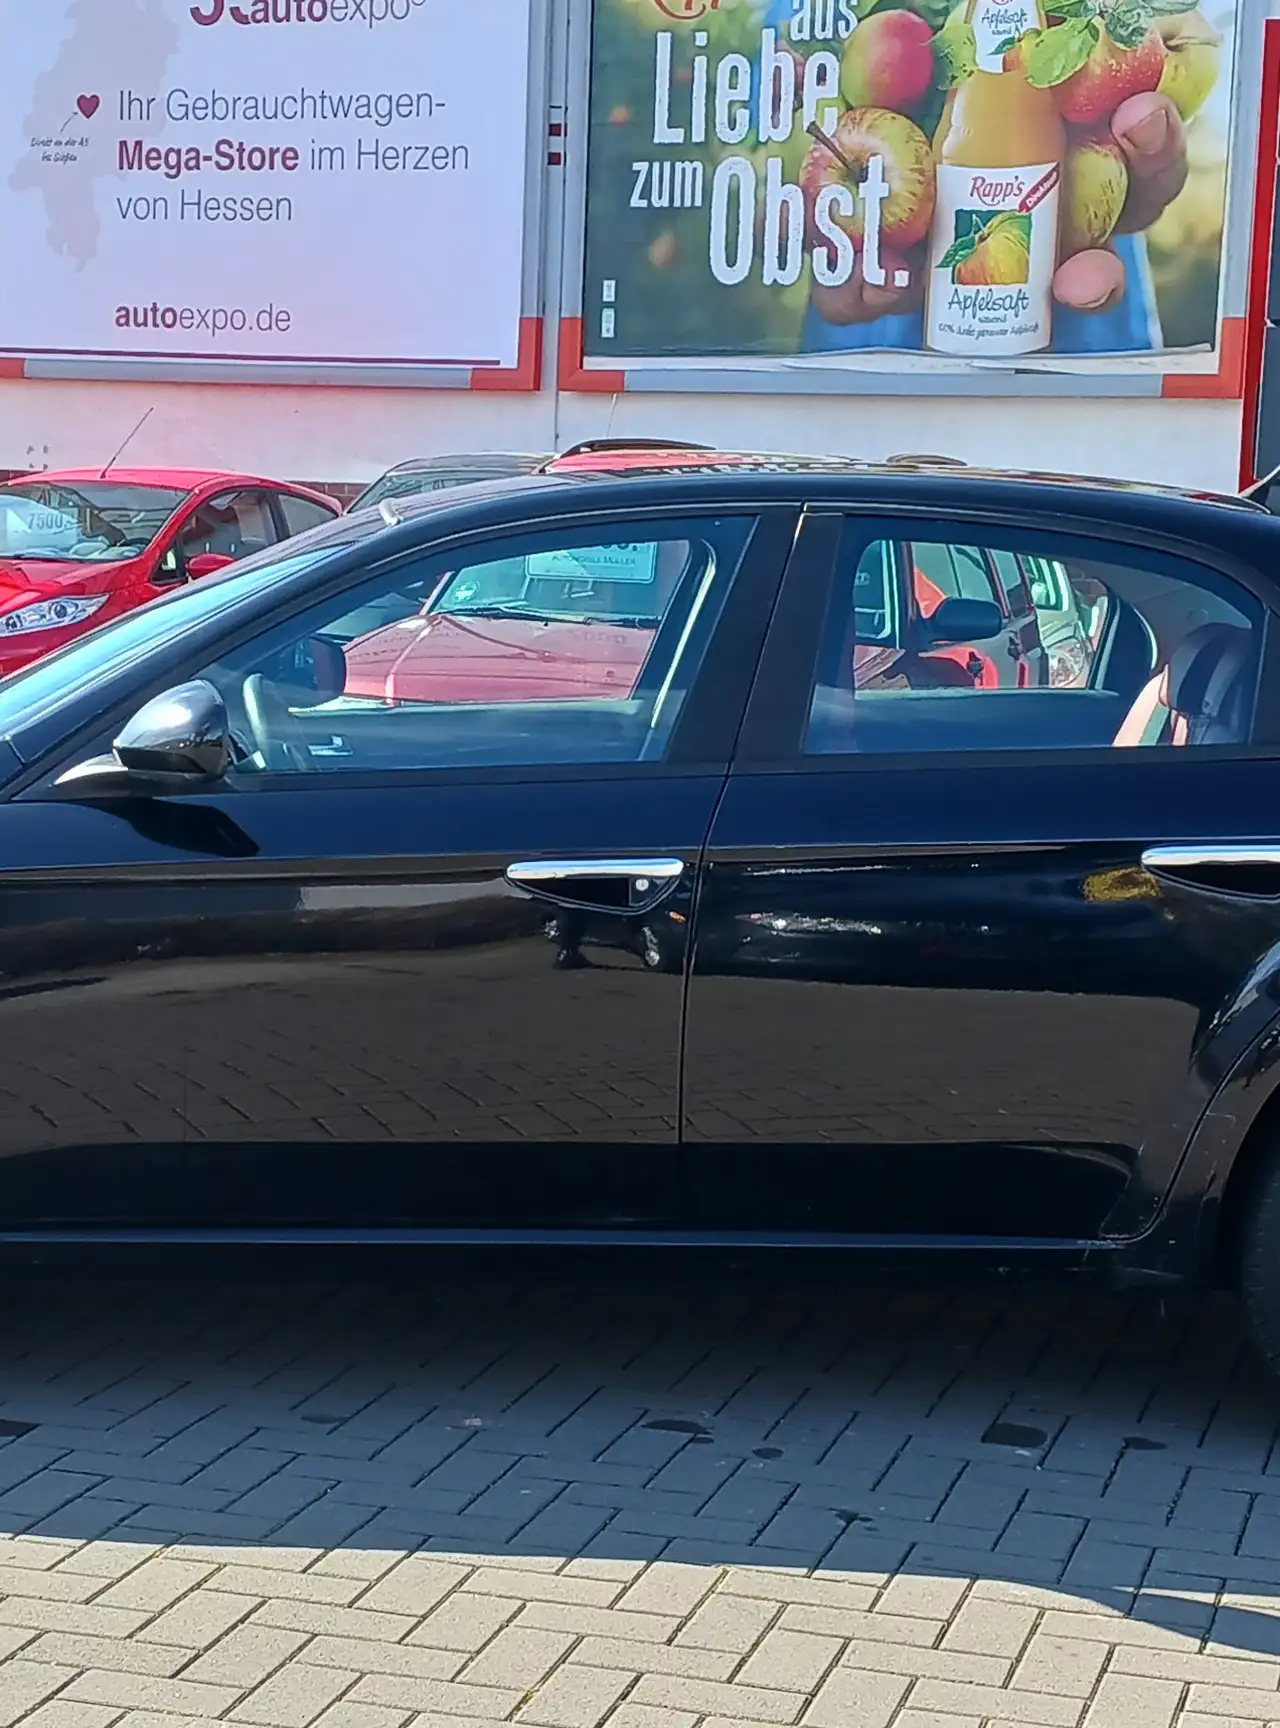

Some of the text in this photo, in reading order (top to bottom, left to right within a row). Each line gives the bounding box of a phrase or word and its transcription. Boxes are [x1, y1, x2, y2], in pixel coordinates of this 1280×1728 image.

[789, 0, 858, 41] aus
[653, 28, 840, 144] Liebe
[119, 88, 446, 127] Ihr Gebrauchtwagen-
[118, 139, 468, 180] Mega-Store im Herzen
[117, 189, 292, 221] von Hessen
[970, 175, 1025, 206] Rapp's
[630, 153, 910, 287] zum Obst.
[115, 302, 291, 337] autoexpo.de
[948, 288, 1029, 319] Apfelsaft
